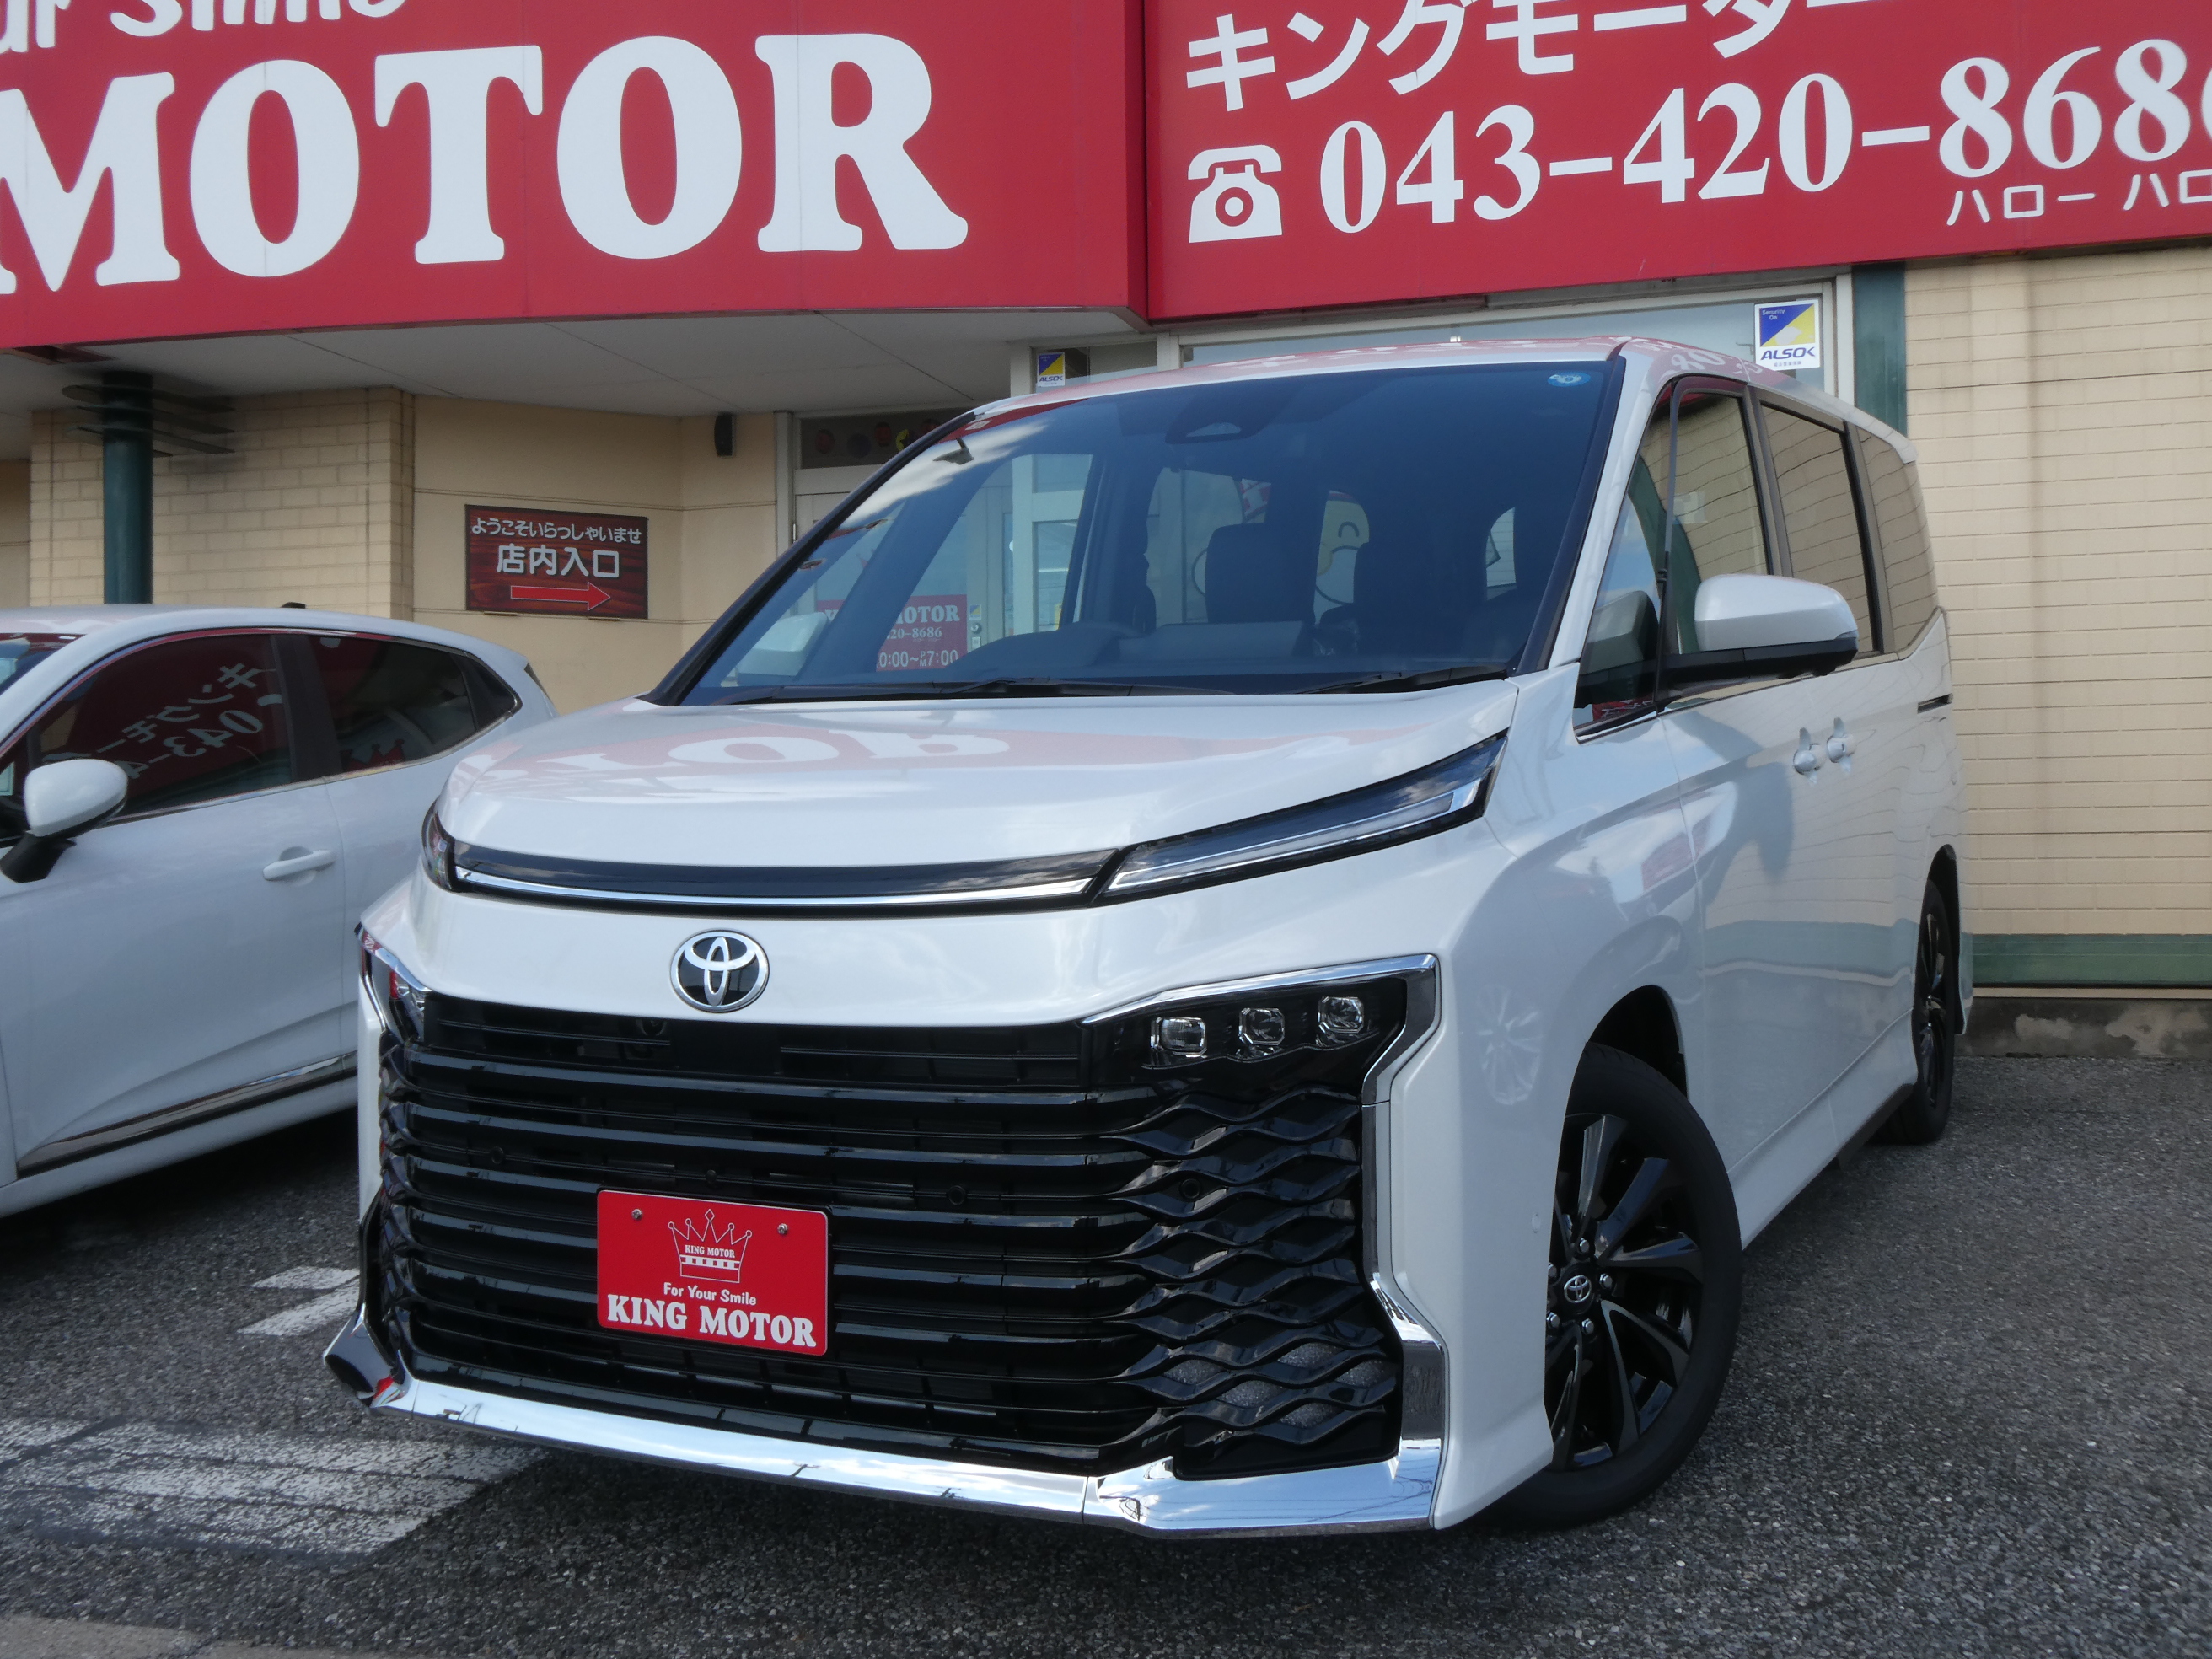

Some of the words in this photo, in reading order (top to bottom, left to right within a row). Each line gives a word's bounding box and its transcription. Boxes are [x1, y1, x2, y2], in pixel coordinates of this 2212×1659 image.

[1185, 0, 1873, 111] キングモータ
[1320, 39, 2212, 234] 043-420-868
[0, 32, 968, 293] MOTOR
[1946, 184, 2096, 226] ハロー
[1760, 346, 1816, 361] ALSOK
[496, 543, 620, 578] 店内入口
[685, 1244, 705, 1256] KING
[706, 1246, 736, 1259] MOTOR
[663, 1281, 685, 1297] For
[687, 1285, 717, 1302] Your
[720, 1289, 757, 1306] Smile
[607, 1294, 688, 1330] KING
[699, 1306, 817, 1349] MOTOR
